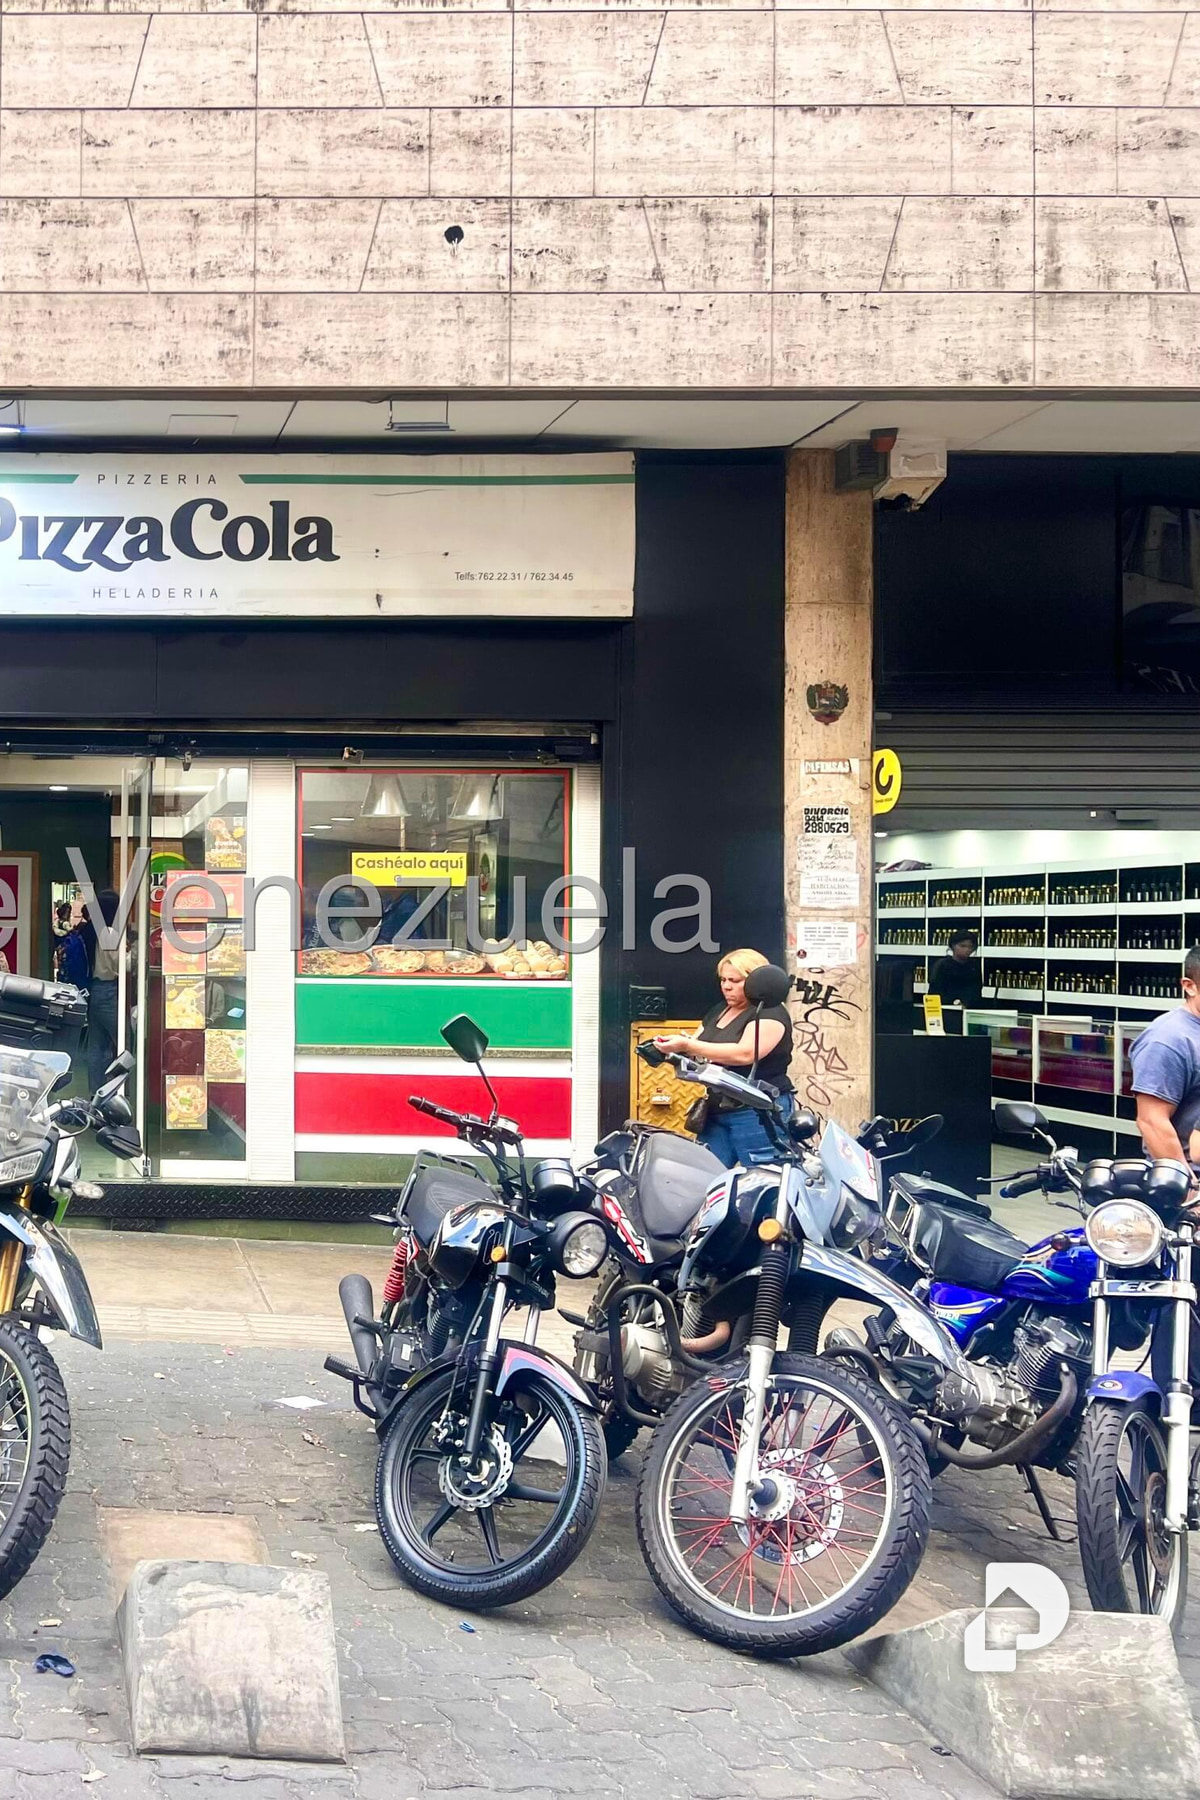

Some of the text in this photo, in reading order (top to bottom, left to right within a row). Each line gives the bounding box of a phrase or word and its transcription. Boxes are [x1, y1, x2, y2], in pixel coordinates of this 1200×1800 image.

[97, 474, 217, 485] PIZZERIA
[530, 572, 574, 581] 762.34.45
[92, 587, 219, 599] HELADERIA
[804, 822, 849, 833] 2880529
[355, 855, 464, 872] Cashéalo aquí
